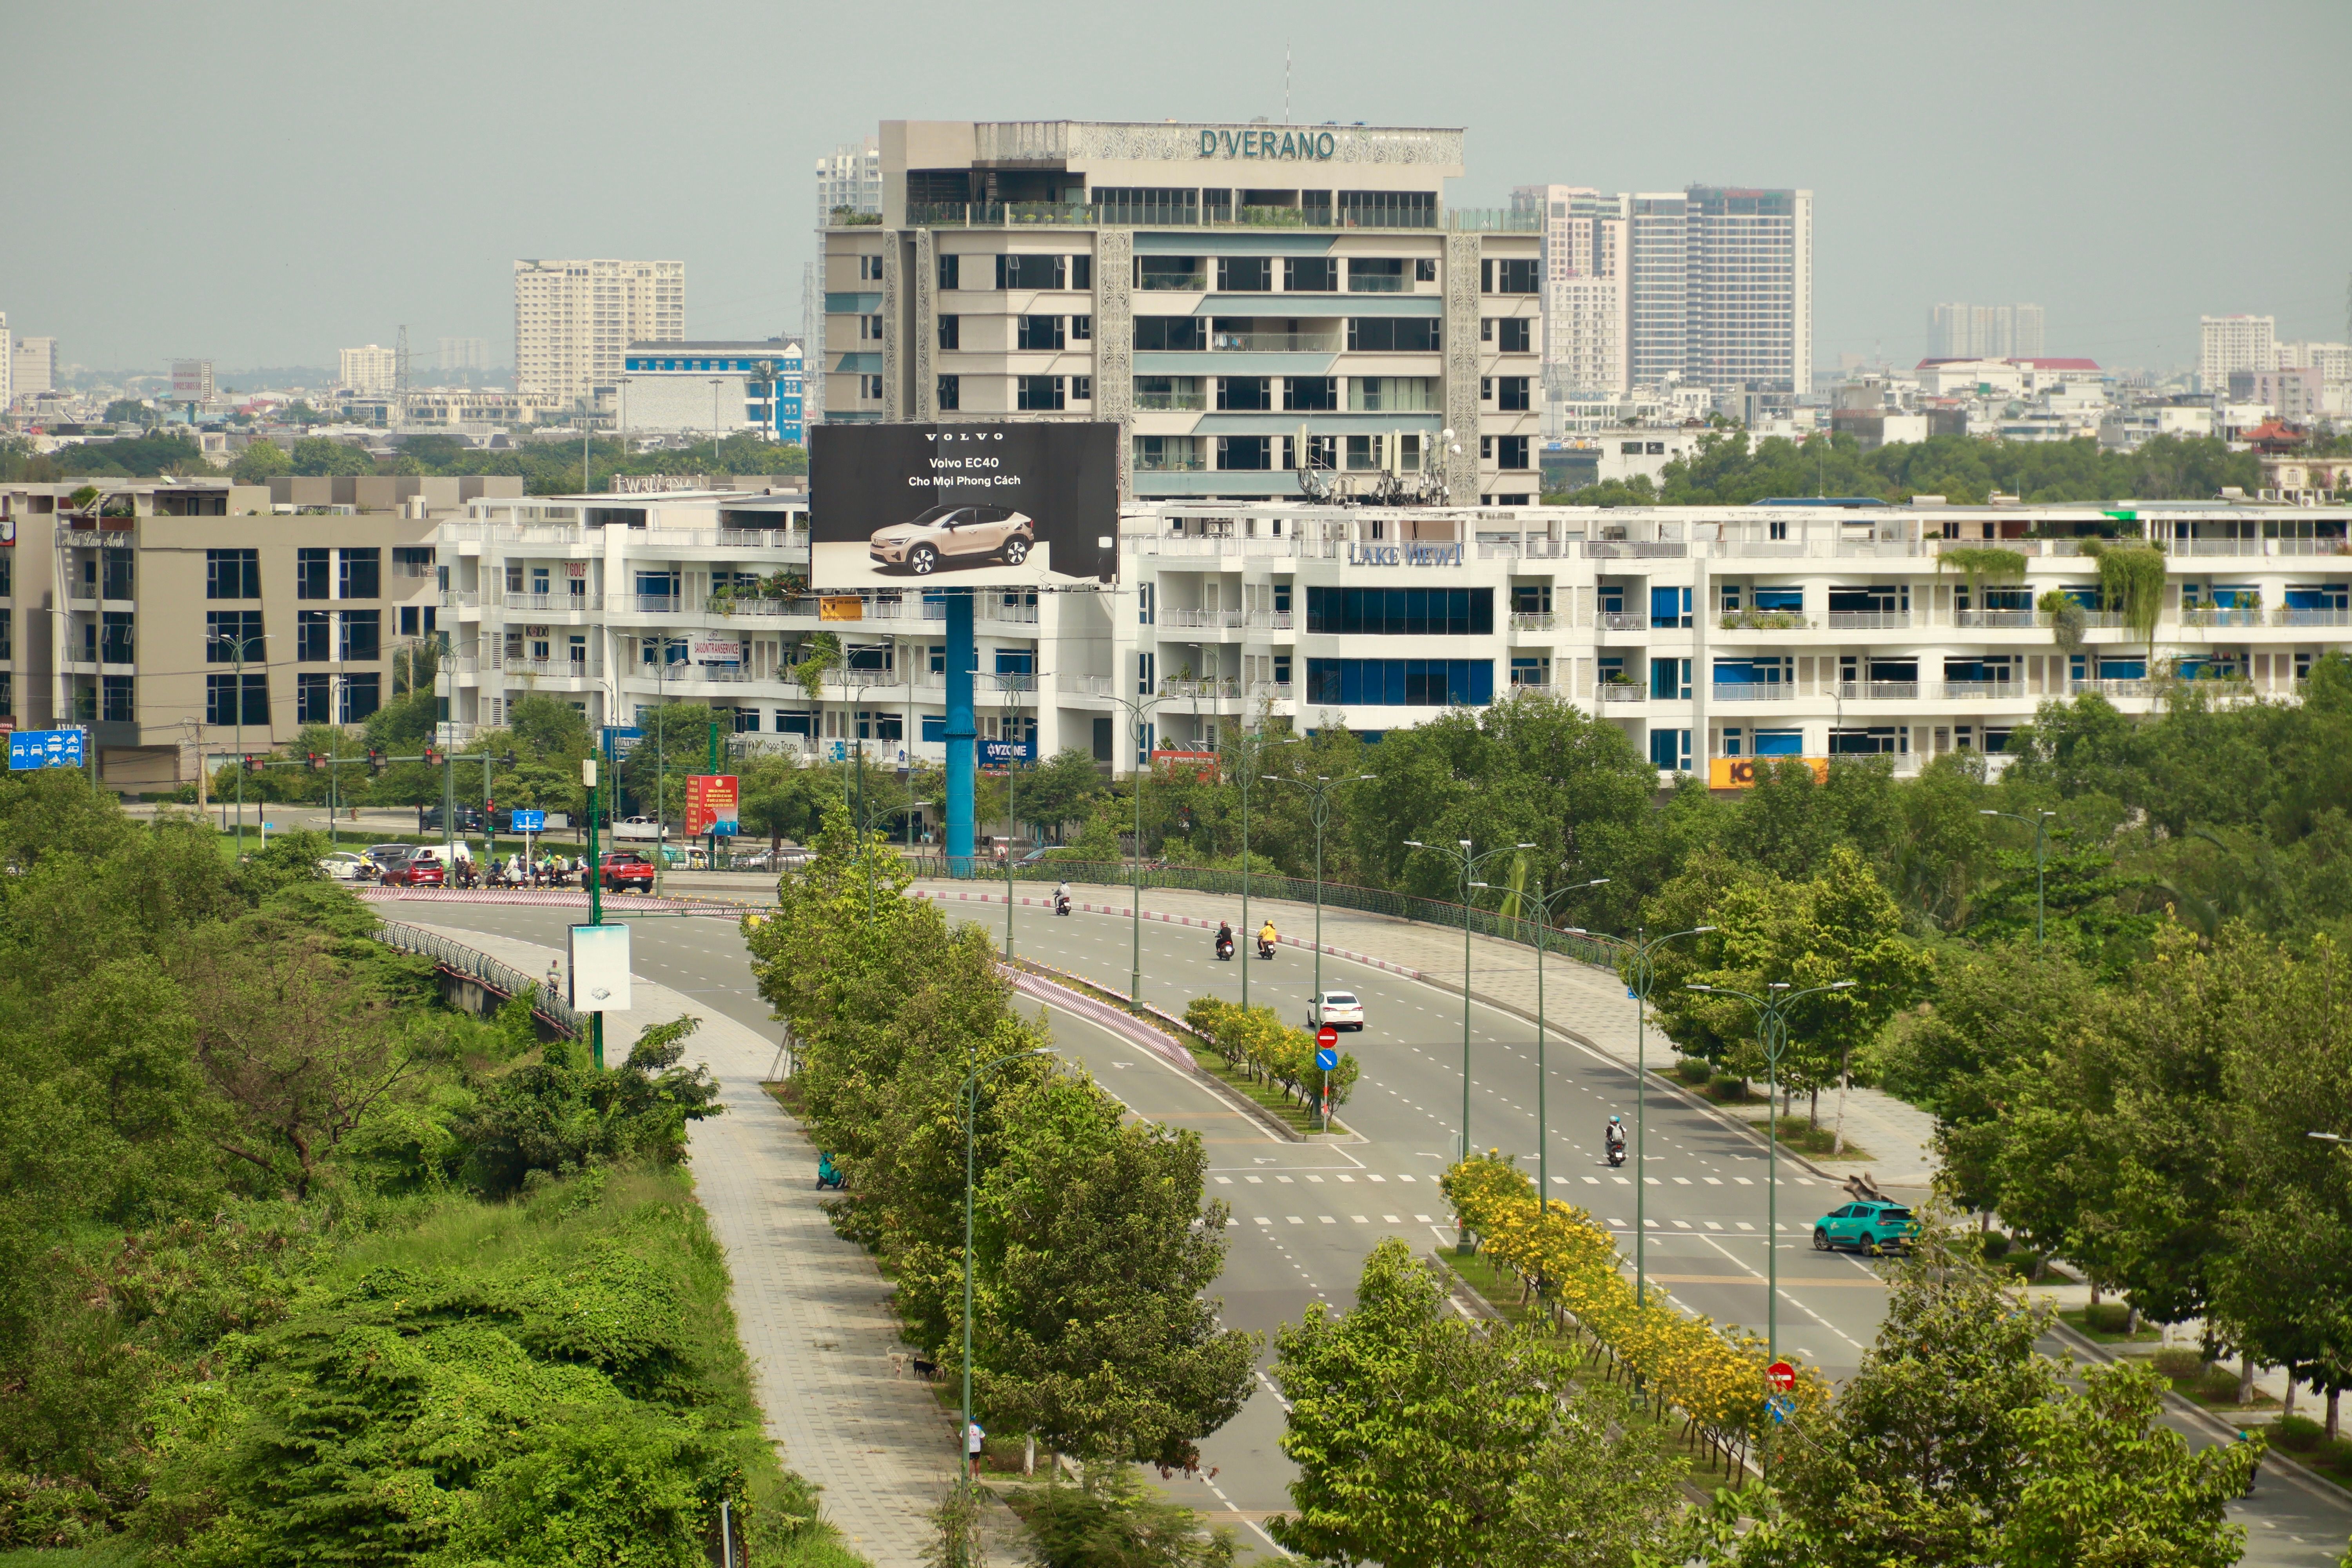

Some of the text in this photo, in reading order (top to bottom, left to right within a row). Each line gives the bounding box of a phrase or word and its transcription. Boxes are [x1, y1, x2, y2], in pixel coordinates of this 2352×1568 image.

[1200, 130, 1334, 157] D'VERANO
[925, 433, 1003, 441] VOLVO
[929, 458, 999, 468] Volvo EC40
[909, 475, 1021, 488] Cho Mọi Phong Cách
[62, 530, 125, 547] Mai Lan Anh
[1350, 543, 1399, 564] LAKE
[1405, 544, 1452, 565] VIEW
[564, 563, 586, 577] 7 GOLF
[695, 642, 738, 654] SAIGONTRANSERVICE
[781, 741, 799, 753] Trung
